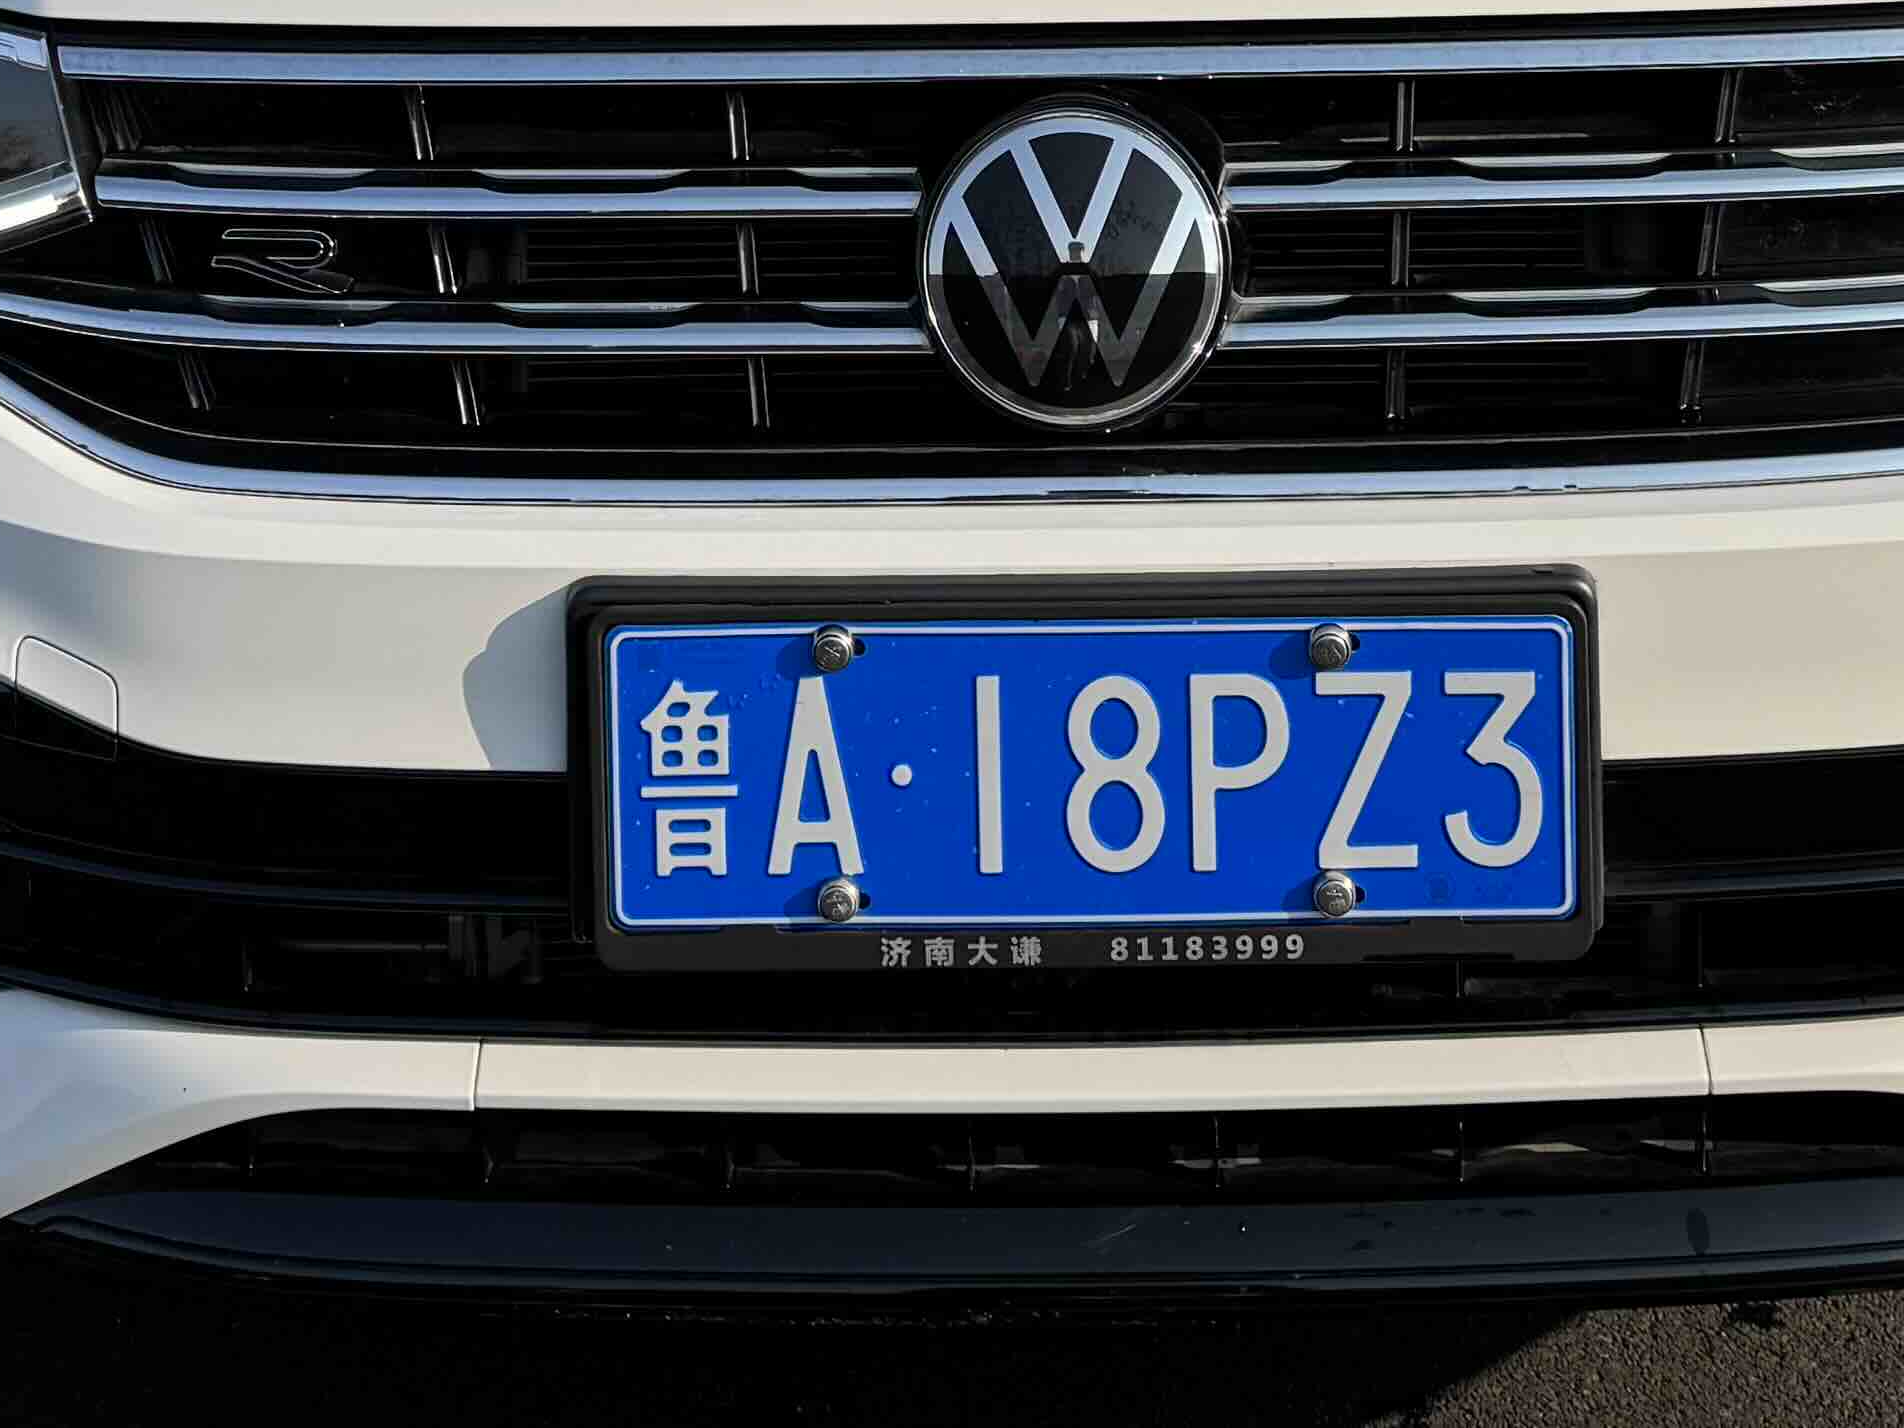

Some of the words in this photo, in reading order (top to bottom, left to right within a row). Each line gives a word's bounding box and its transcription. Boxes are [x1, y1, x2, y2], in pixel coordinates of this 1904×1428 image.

[880, 936, 1042, 968] 济南大谦
[1109, 934, 1305, 962] 81183999
